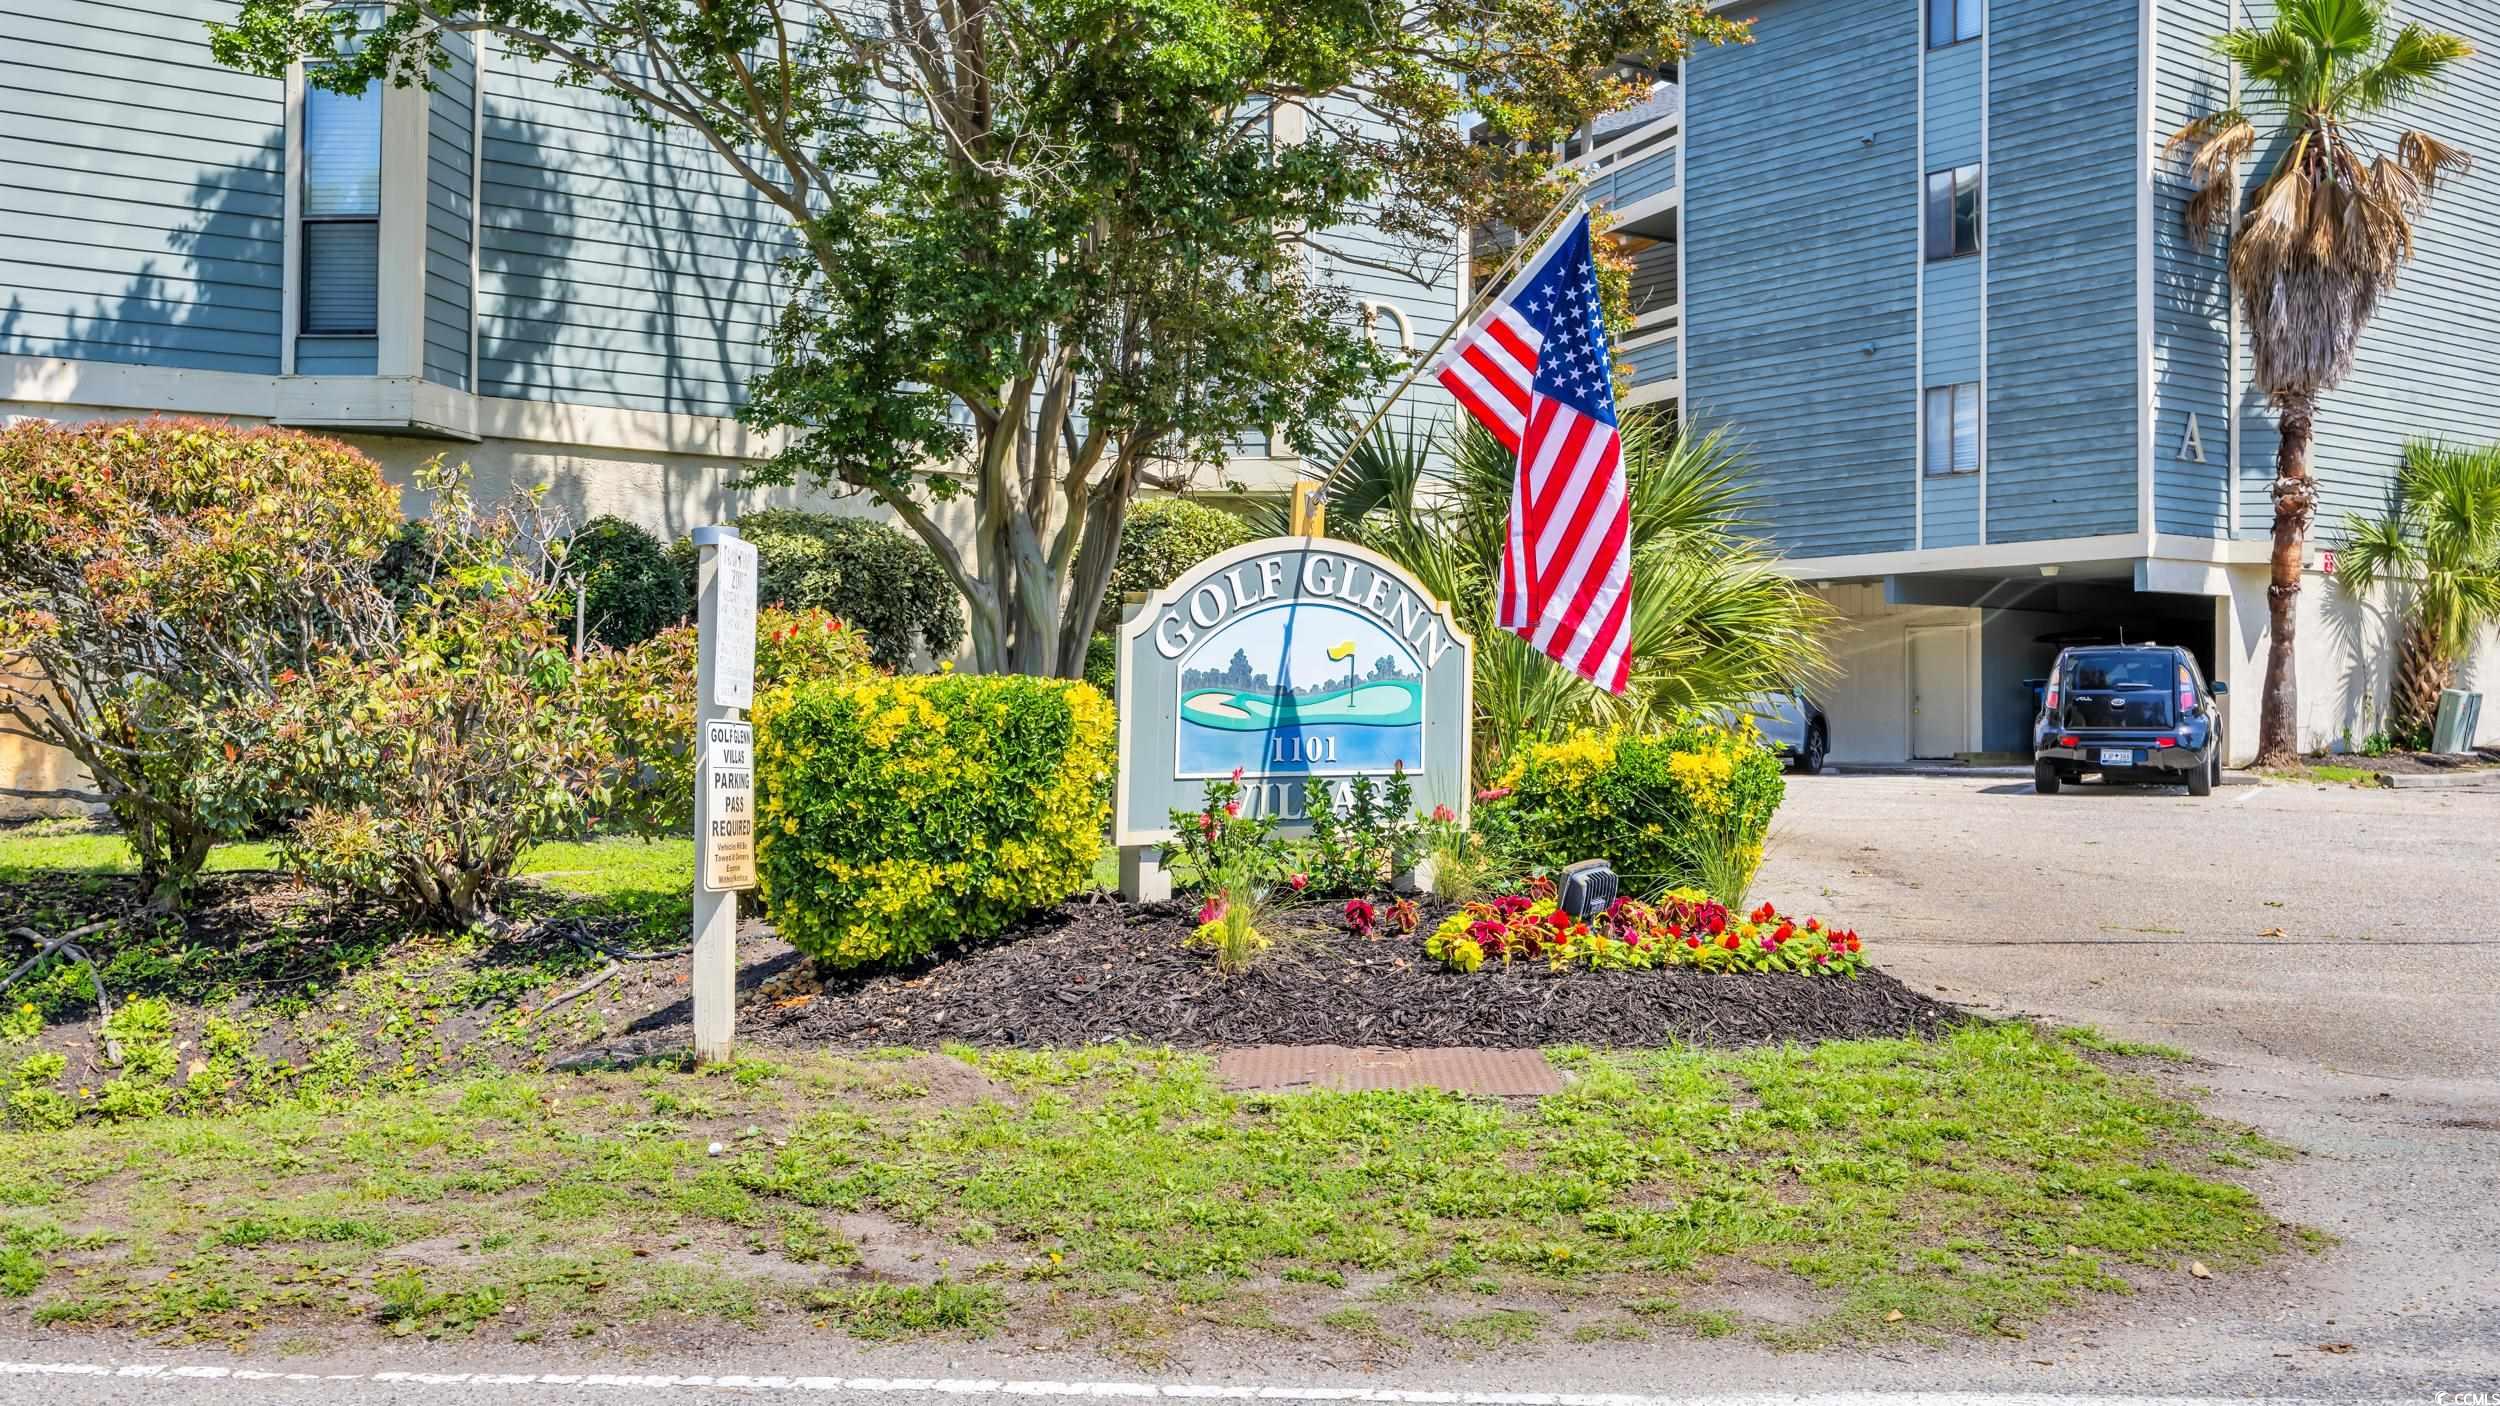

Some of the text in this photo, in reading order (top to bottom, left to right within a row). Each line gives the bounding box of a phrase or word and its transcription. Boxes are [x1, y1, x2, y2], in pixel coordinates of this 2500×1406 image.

[2176, 411, 2207, 463] A
[1155, 554, 1453, 671] GOLF GLENN
[711, 727, 733, 744] GOLF
[724, 748, 745, 764] VILLAS
[1272, 735, 1337, 762] 1101
[714, 772, 749, 789] PARKING
[725, 796, 744, 813] PASS
[712, 820, 751, 837] REQUIRED
